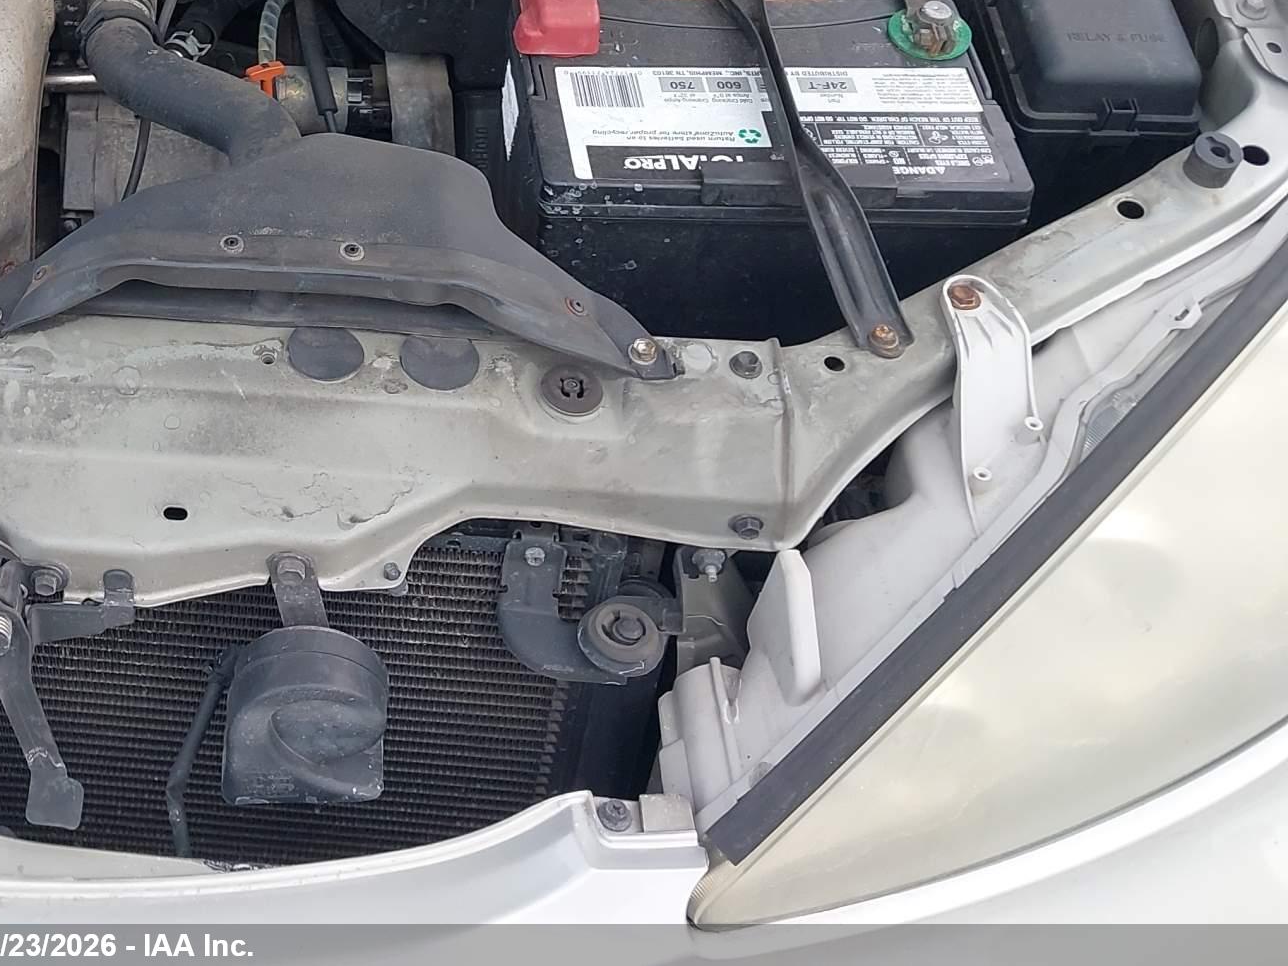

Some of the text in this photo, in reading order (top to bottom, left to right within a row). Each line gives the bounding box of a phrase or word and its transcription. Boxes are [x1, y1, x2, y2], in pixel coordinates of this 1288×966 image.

[1065, 32, 1112, 43] RELAY
[670, 81, 695, 90] 750
[716, 81, 742, 90] 600
[808, 81, 848, 90] 24F-T
[892, 166, 936, 174] DANGE
